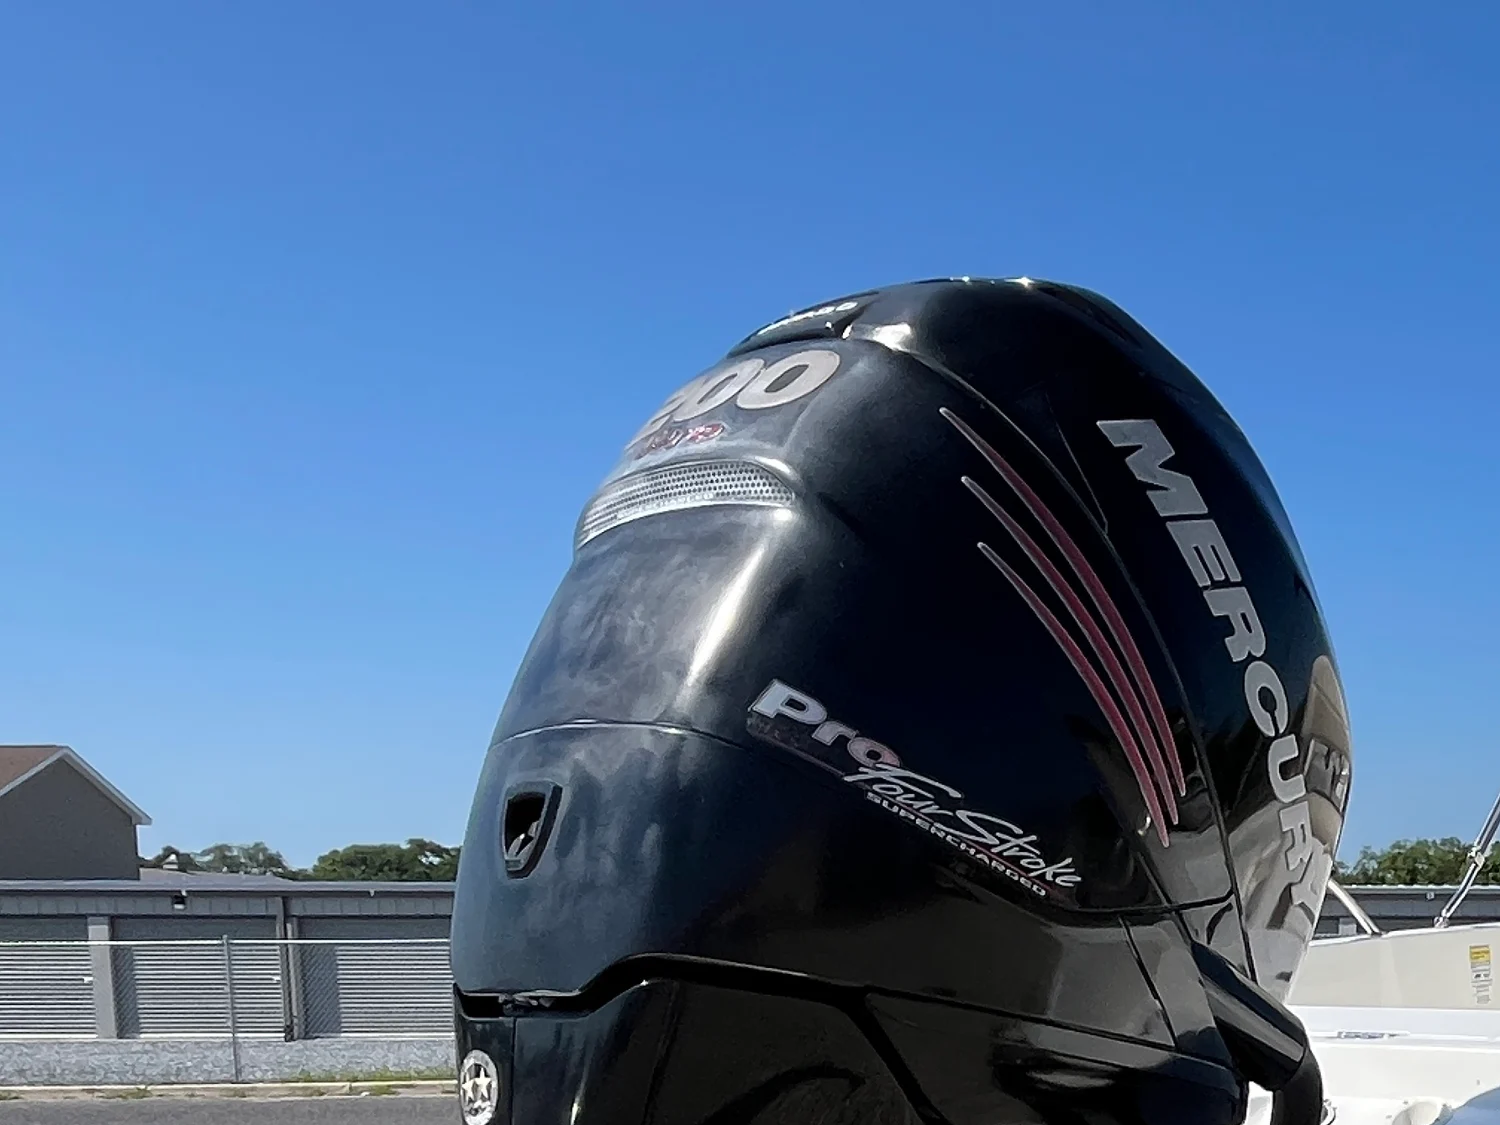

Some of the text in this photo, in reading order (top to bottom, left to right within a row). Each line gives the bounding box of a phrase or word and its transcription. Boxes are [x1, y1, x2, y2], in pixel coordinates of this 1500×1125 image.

[1096, 418, 1328, 914] MERCURY
[747, 678, 901, 768] Pro
[866, 792, 1046, 897] SUPERCHARGED
